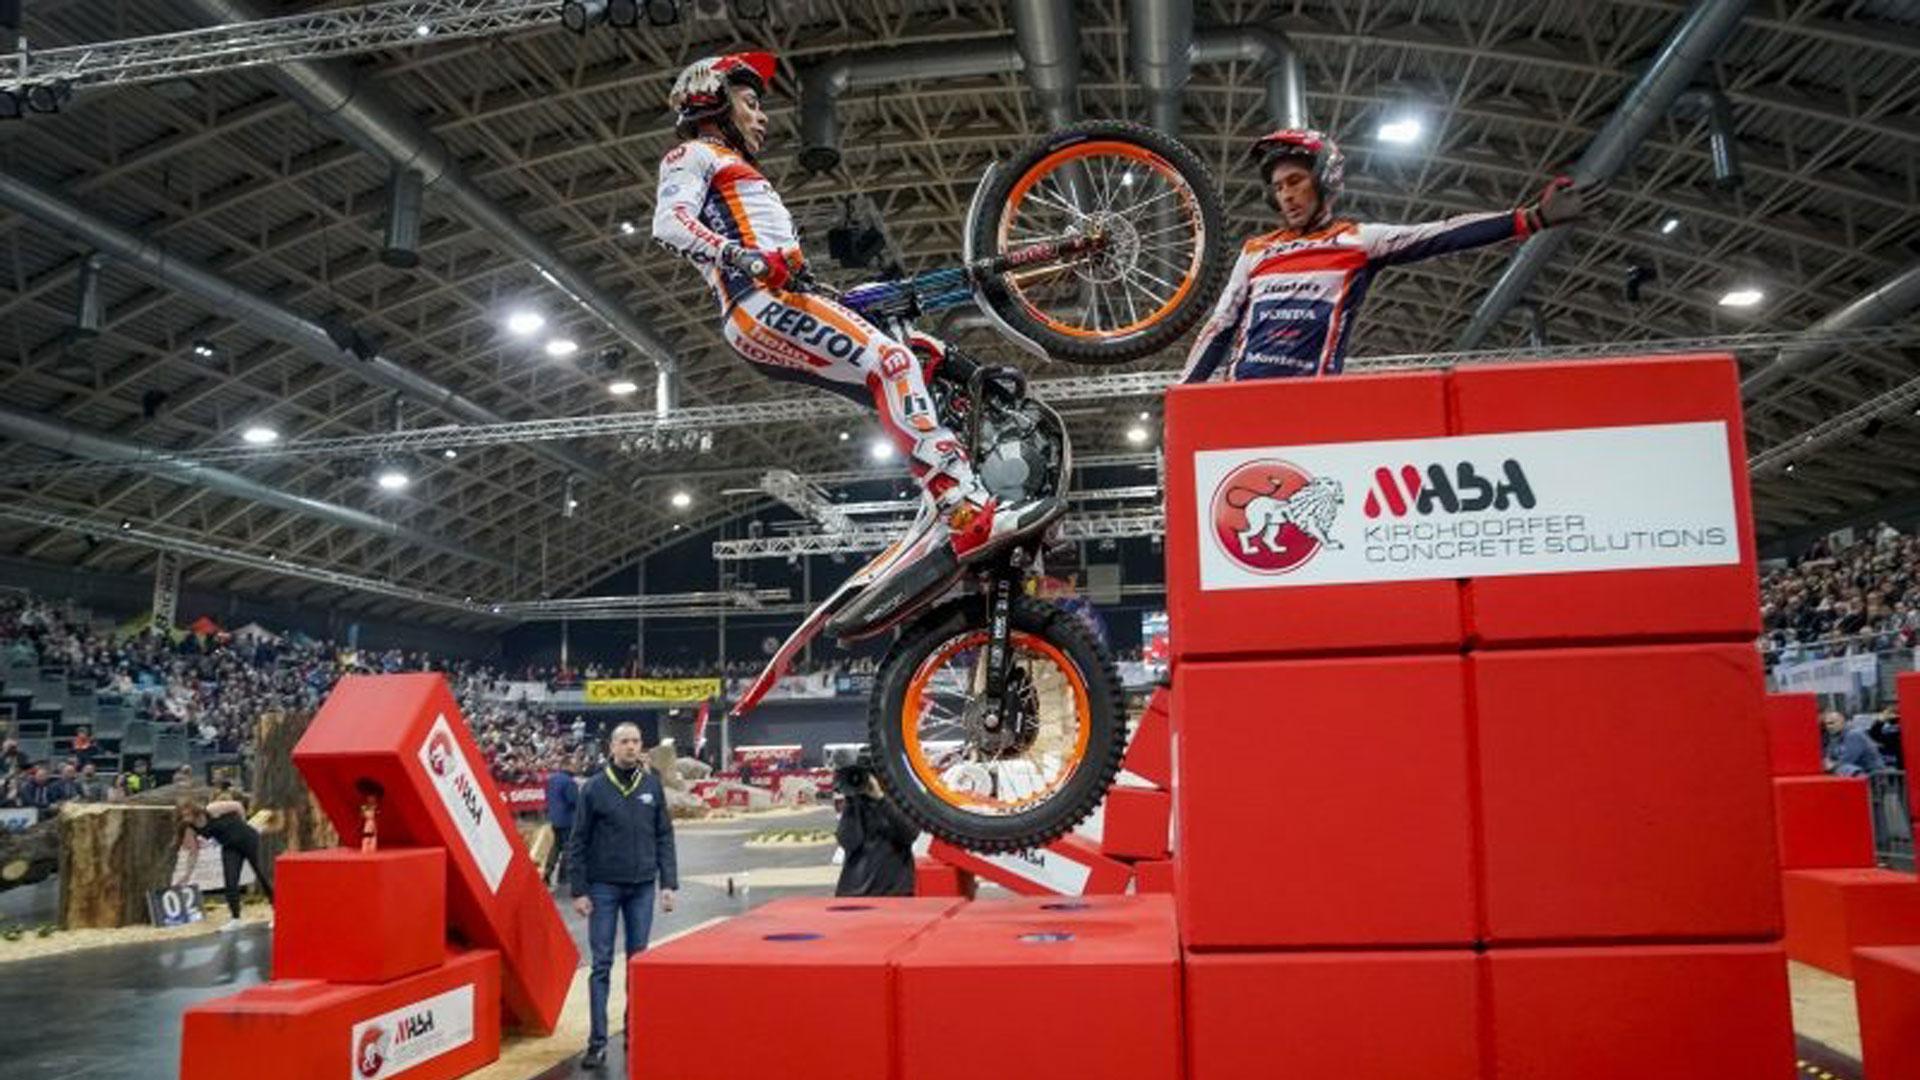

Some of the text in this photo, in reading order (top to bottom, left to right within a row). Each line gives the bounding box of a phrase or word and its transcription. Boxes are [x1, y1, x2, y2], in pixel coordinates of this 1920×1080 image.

[756, 302, 868, 367] REPSOL
[1363, 514, 1585, 542] KIRCHDORFER
[1365, 526, 1728, 563] CONCRETE SOLUTIONS
